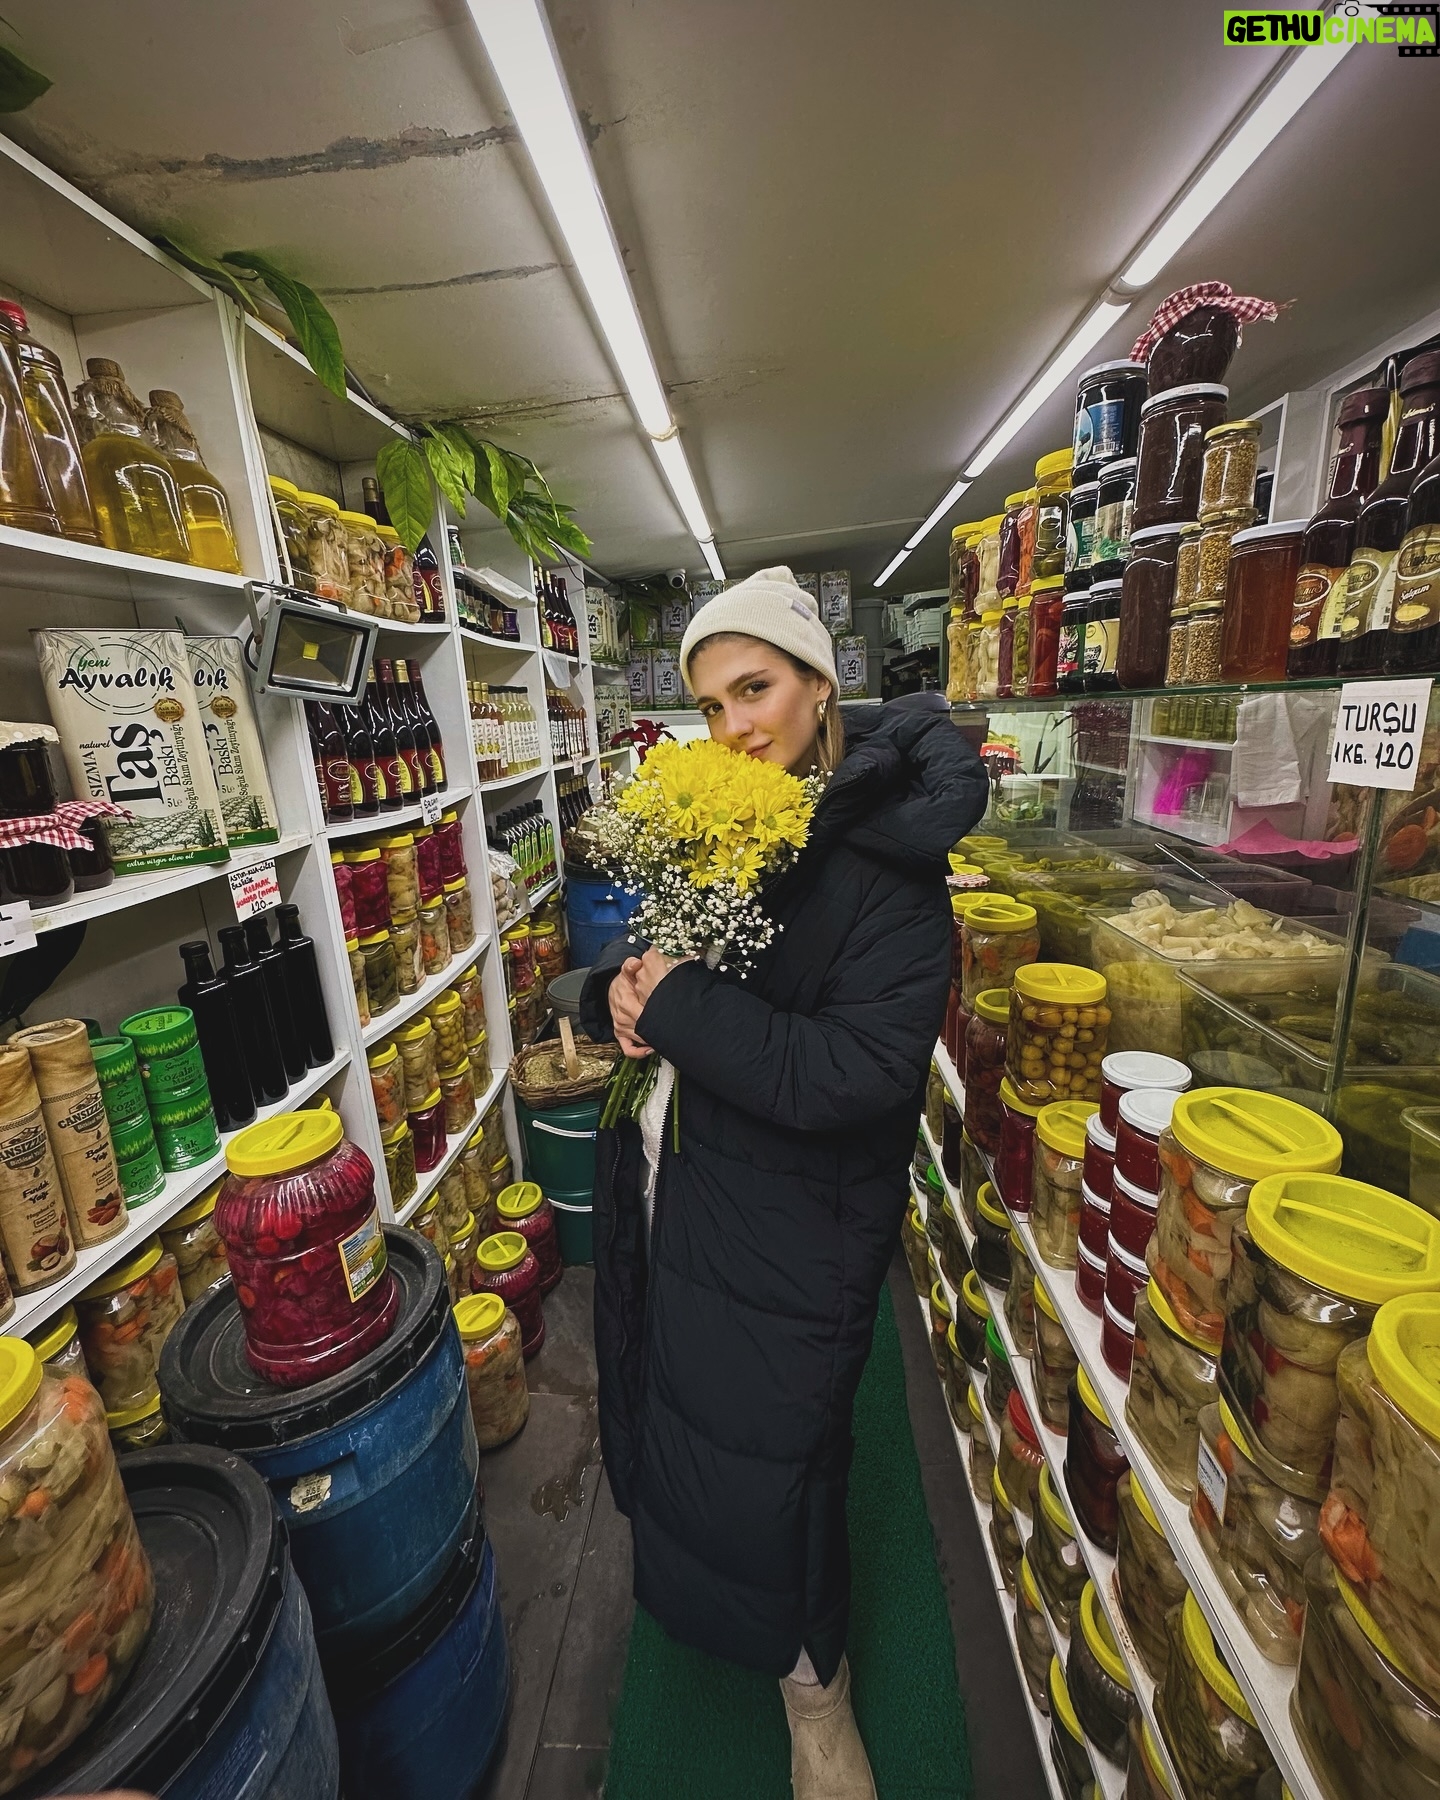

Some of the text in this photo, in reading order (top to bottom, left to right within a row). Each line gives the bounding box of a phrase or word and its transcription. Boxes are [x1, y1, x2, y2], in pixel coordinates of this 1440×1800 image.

[59, 667, 176, 693] Ayvalık
[1342, 702, 1416, 736] TURŞU
[79, 740, 111, 749] naturel
[213, 737, 234, 776] Baskı
[1375, 741, 1414, 770] 120
[82, 751, 105, 797] SIZMA
[105, 723, 165, 804] Taş
[157, 745, 182, 788] Baskı
